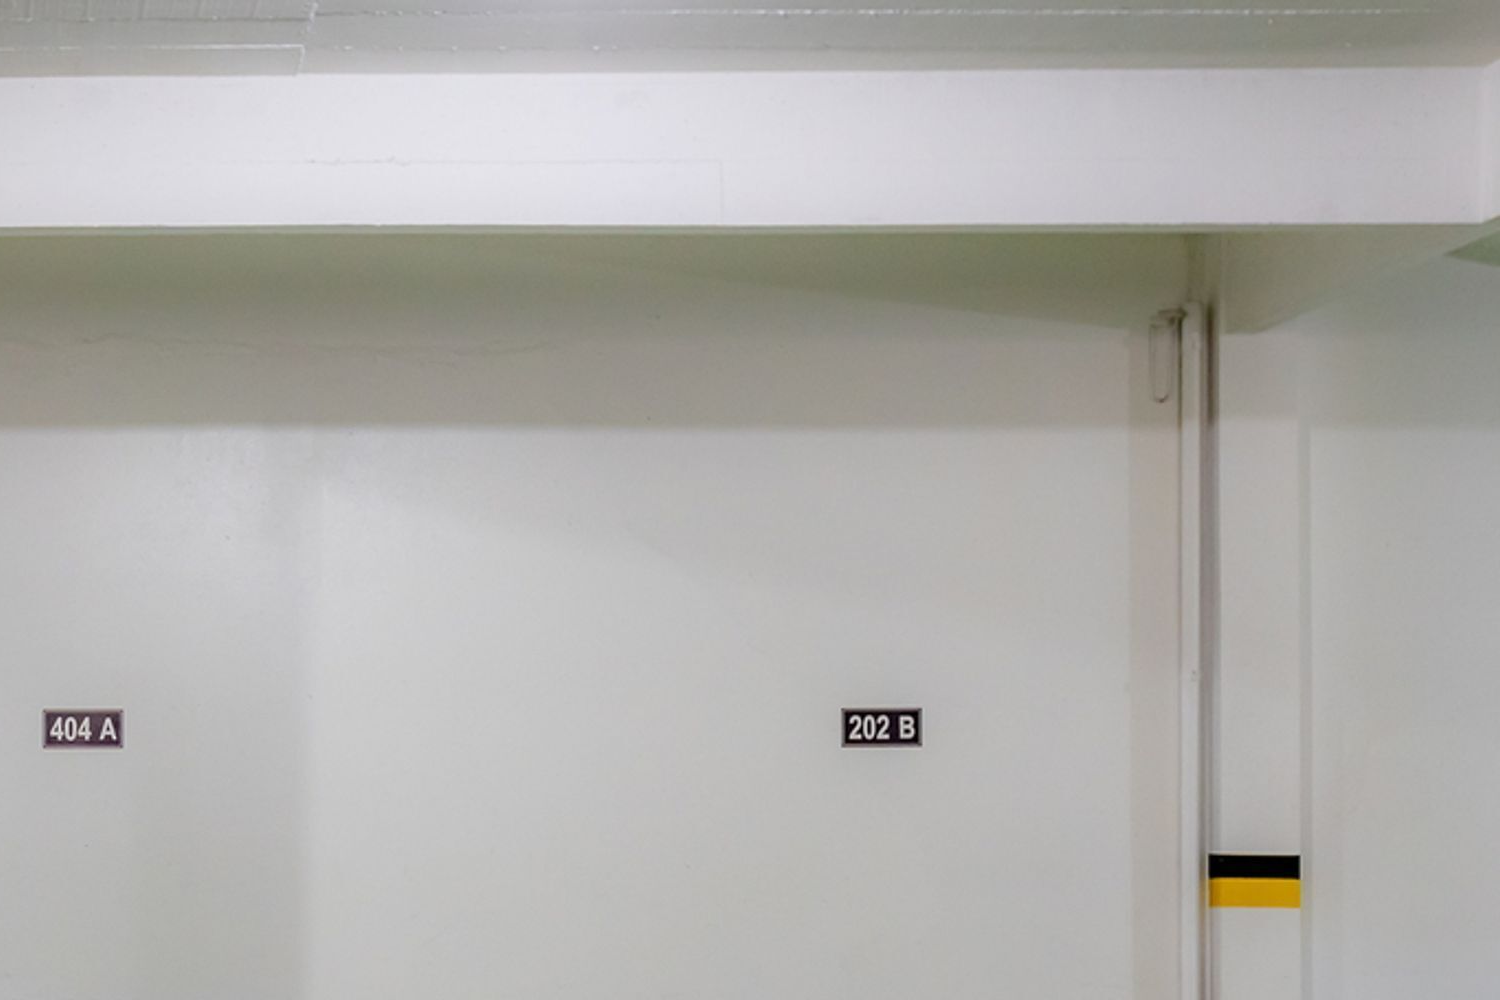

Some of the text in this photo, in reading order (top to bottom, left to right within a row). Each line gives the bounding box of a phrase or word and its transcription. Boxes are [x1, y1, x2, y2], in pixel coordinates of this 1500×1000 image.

[49, 716, 117, 741] 404 A
[848, 714, 916, 741] 202 B
